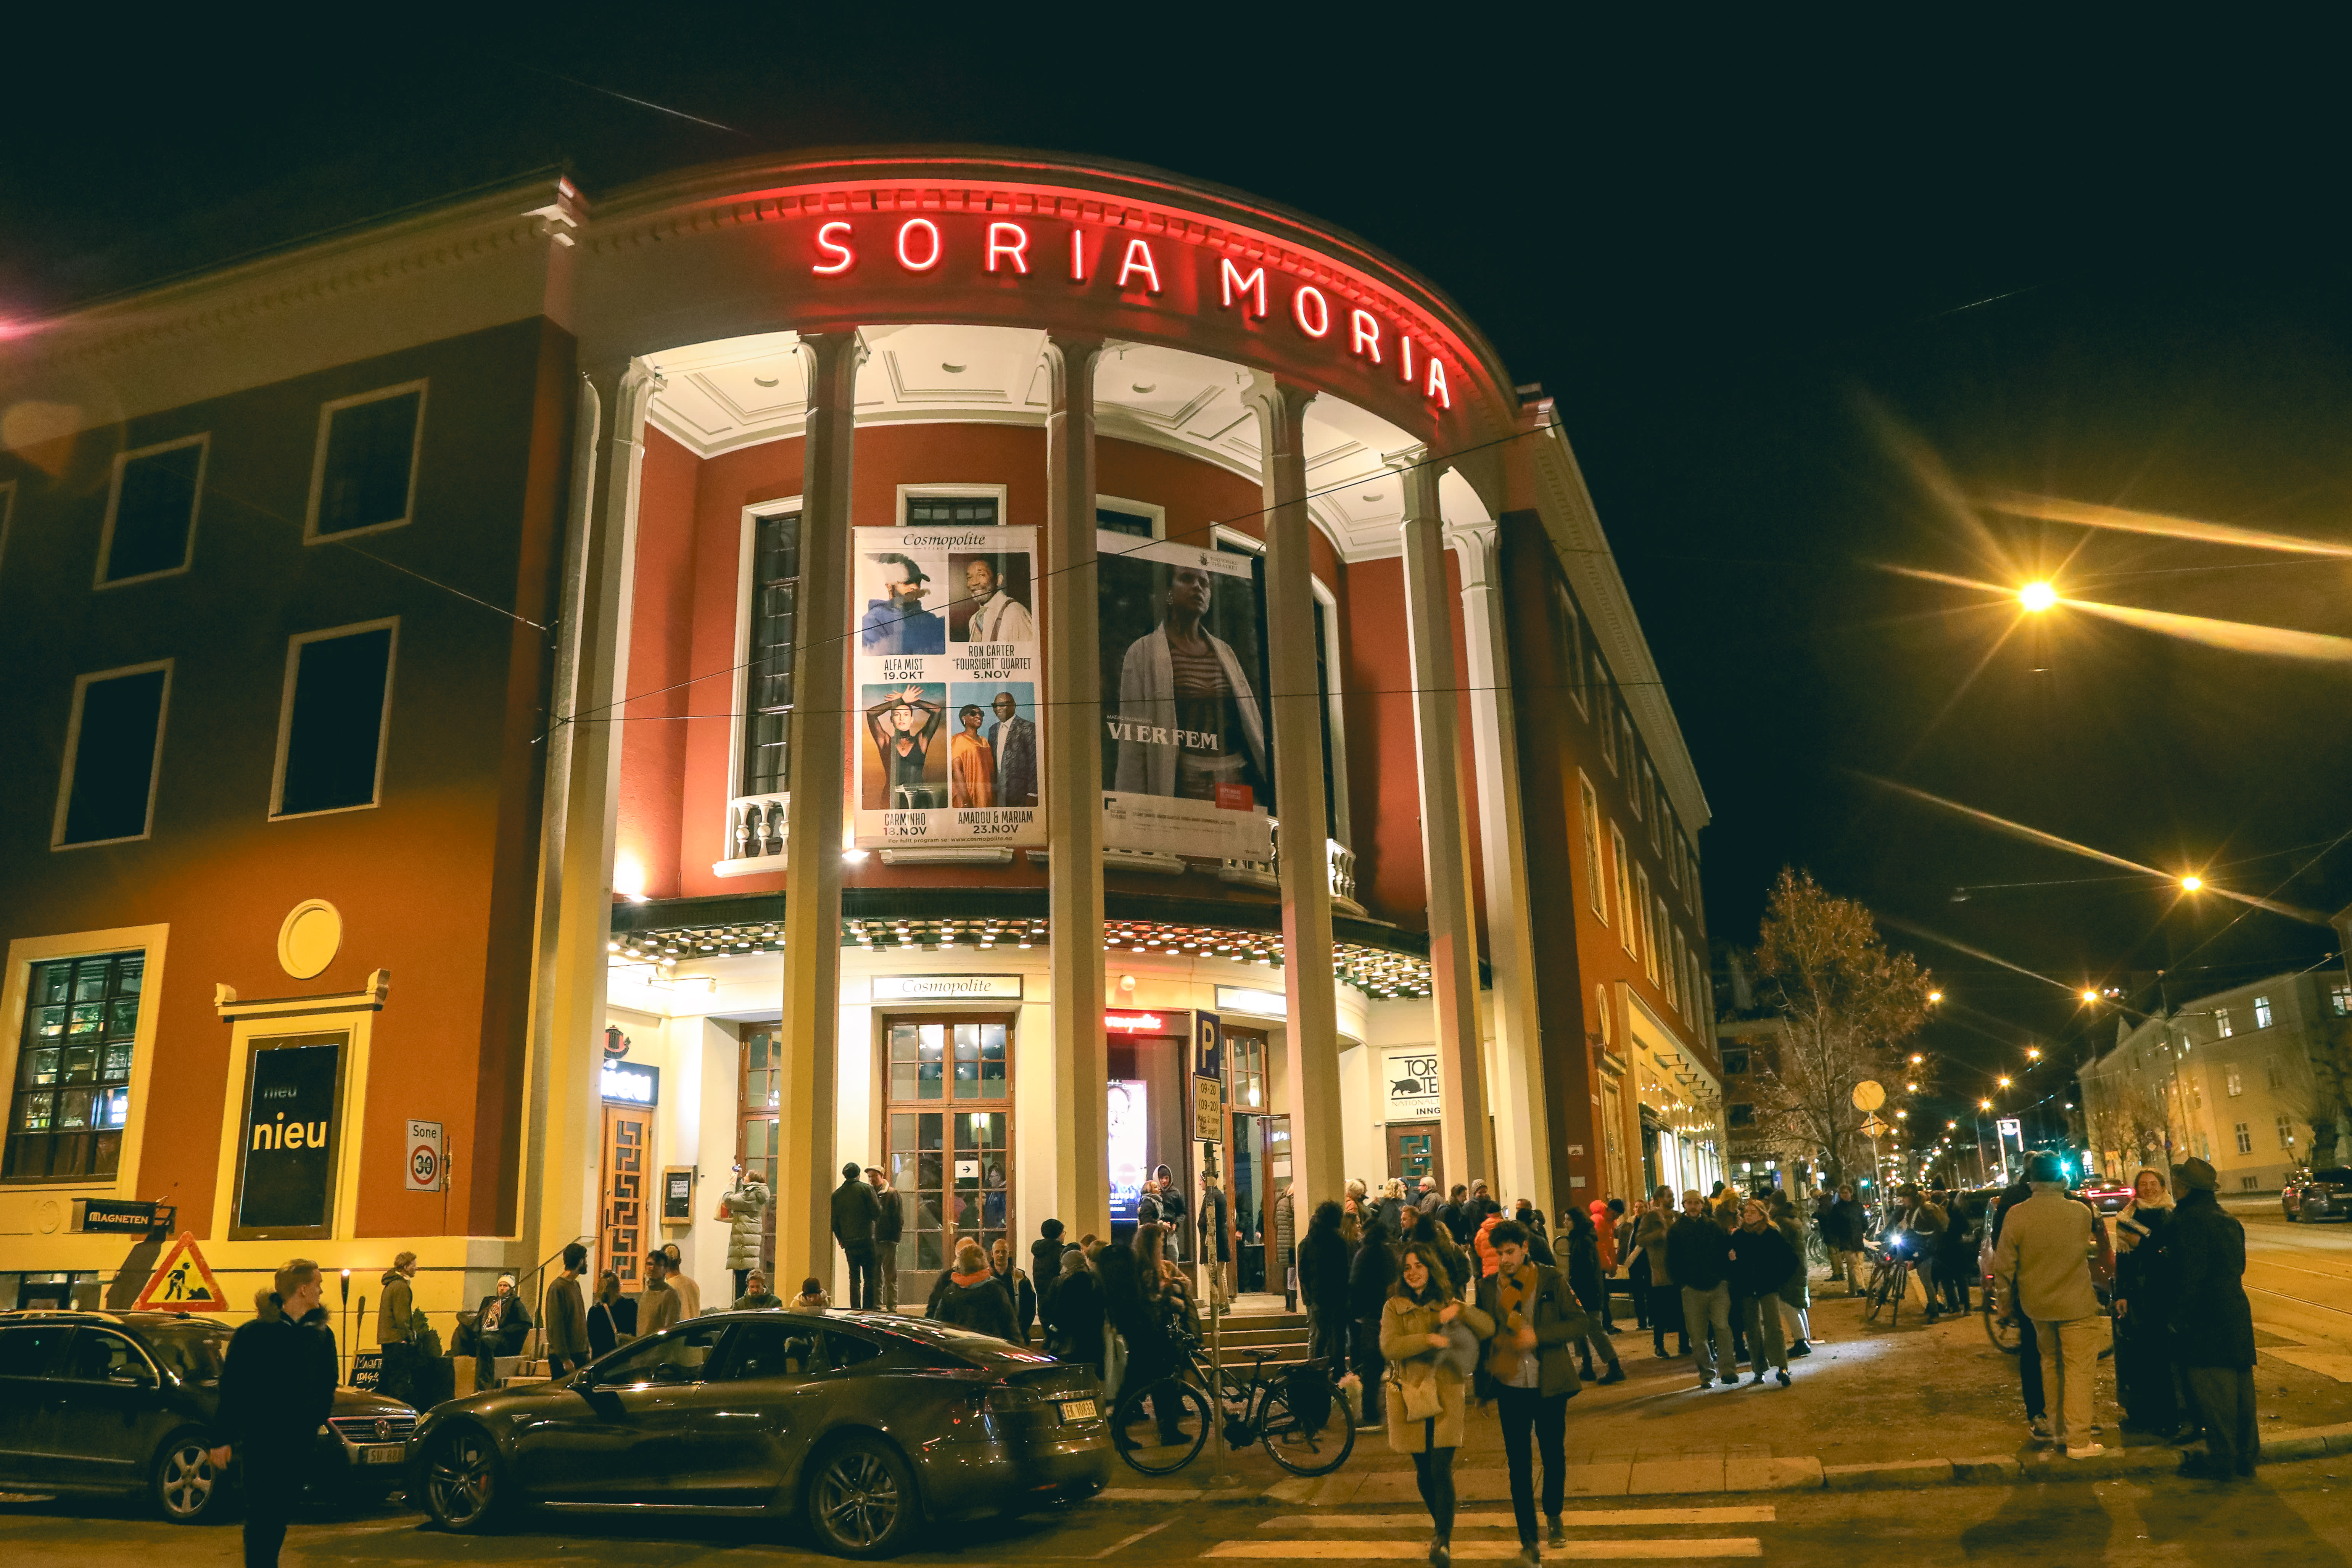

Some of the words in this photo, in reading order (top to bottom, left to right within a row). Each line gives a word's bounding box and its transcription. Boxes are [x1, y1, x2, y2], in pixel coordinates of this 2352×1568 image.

[810, 217, 1161, 295] SORIA
[1219, 256, 1453, 410] MORIA
[903, 531, 986, 549] Cosmopolite
[969, 646, 984, 657] RON
[986, 645, 1014, 657] CARTER
[884, 659, 902, 671] ALFA
[905, 658, 923, 670] MIST
[1001, 658, 1031, 670] QUARTET
[884, 671, 924, 680] 19.OKT
[974, 670, 1011, 679] 5.NOV
[1106, 722, 1132, 741] VI
[1136, 725, 1168, 745] ER
[1172, 729, 1219, 750] FEM
[884, 813, 926, 826] CARMINHO
[958, 811, 991, 824] AMADOU
[994, 811, 999, 823] &
[1001, 810, 1034, 823] MARIAM
[973, 824, 1019, 834] 23.NOV
[902, 978, 992, 996] Cosmopolite
[1202, 1020, 1215, 1068] P
[1404, 1059, 1438, 1076] TOR
[1201, 1083, 1216, 1095] 09-20
[1420, 1076, 1439, 1093] TE
[1199, 1098, 1218, 1113] (09-20)
[252, 1112, 327, 1151] nieu
[413, 1125, 437, 1139] Sone
[415, 1154, 432, 1175] 30
[89, 1211, 149, 1225] MAGNETEN
[1066, 1405, 1075, 1418] EK
[1076, 1401, 1094, 1416] 10833
[371, 1449, 382, 1461] SU
